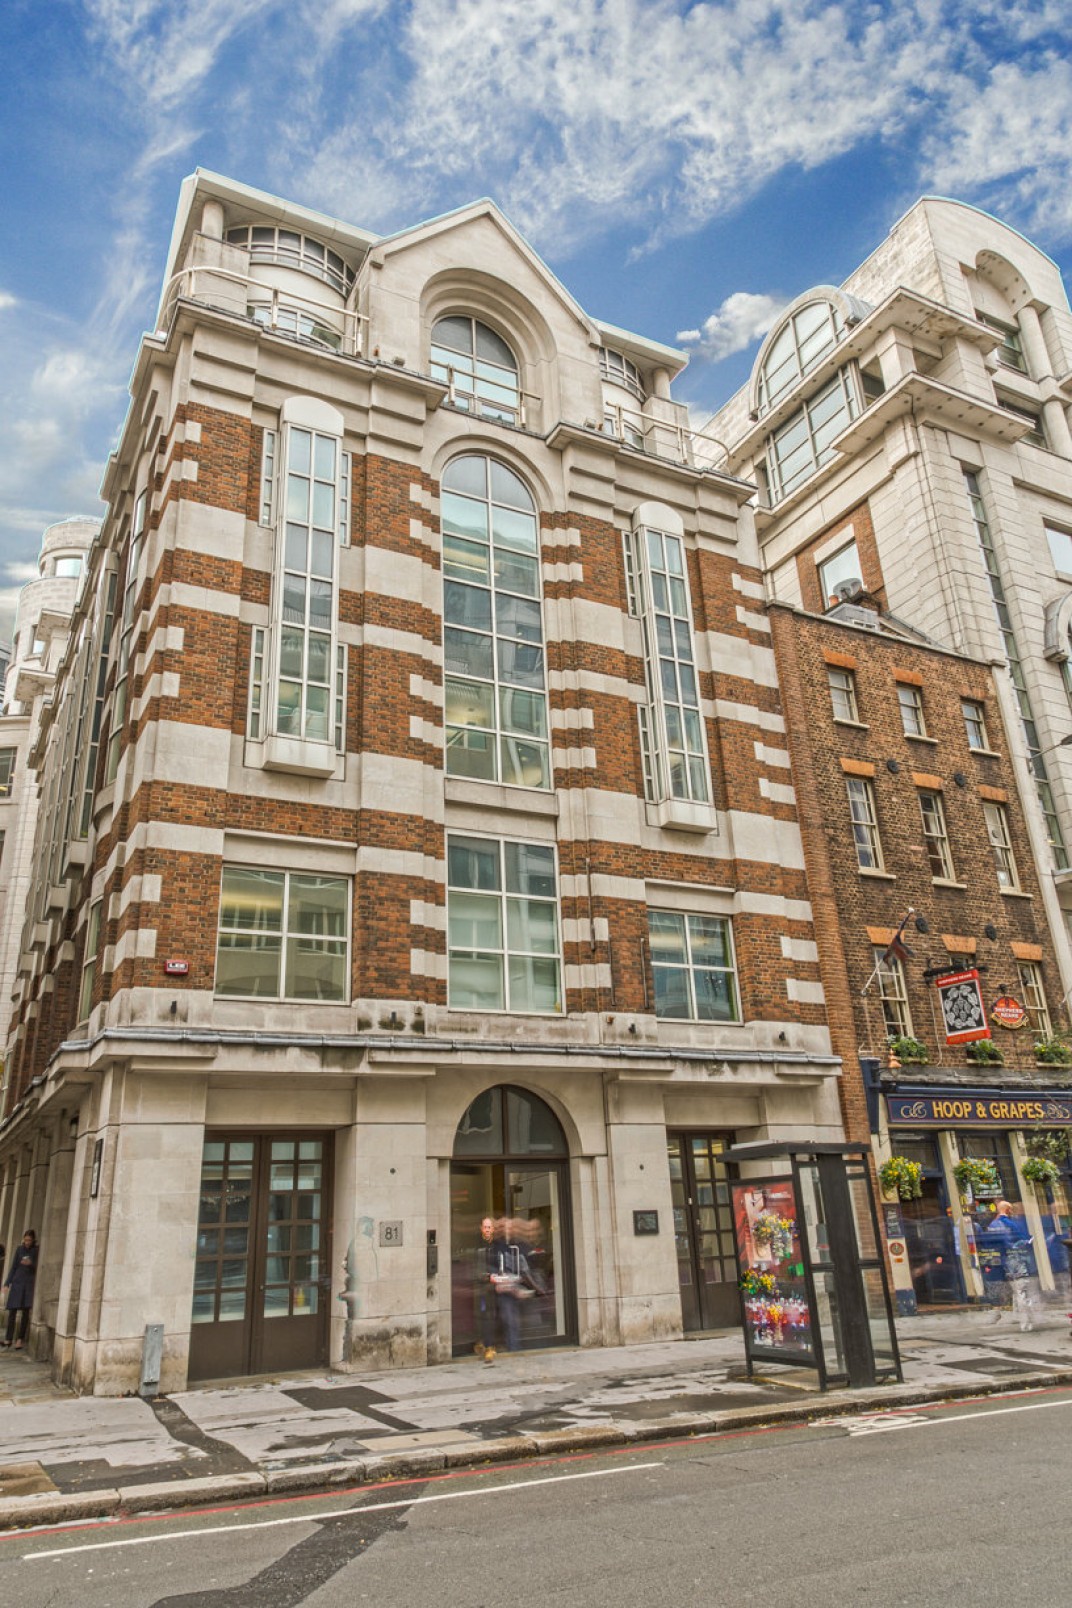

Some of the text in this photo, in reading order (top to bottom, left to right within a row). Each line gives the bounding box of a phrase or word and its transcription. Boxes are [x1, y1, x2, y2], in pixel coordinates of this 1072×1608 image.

[932, 1101, 1044, 1119] HOOP & GRAPES
[384, 1226, 399, 1240] 81
